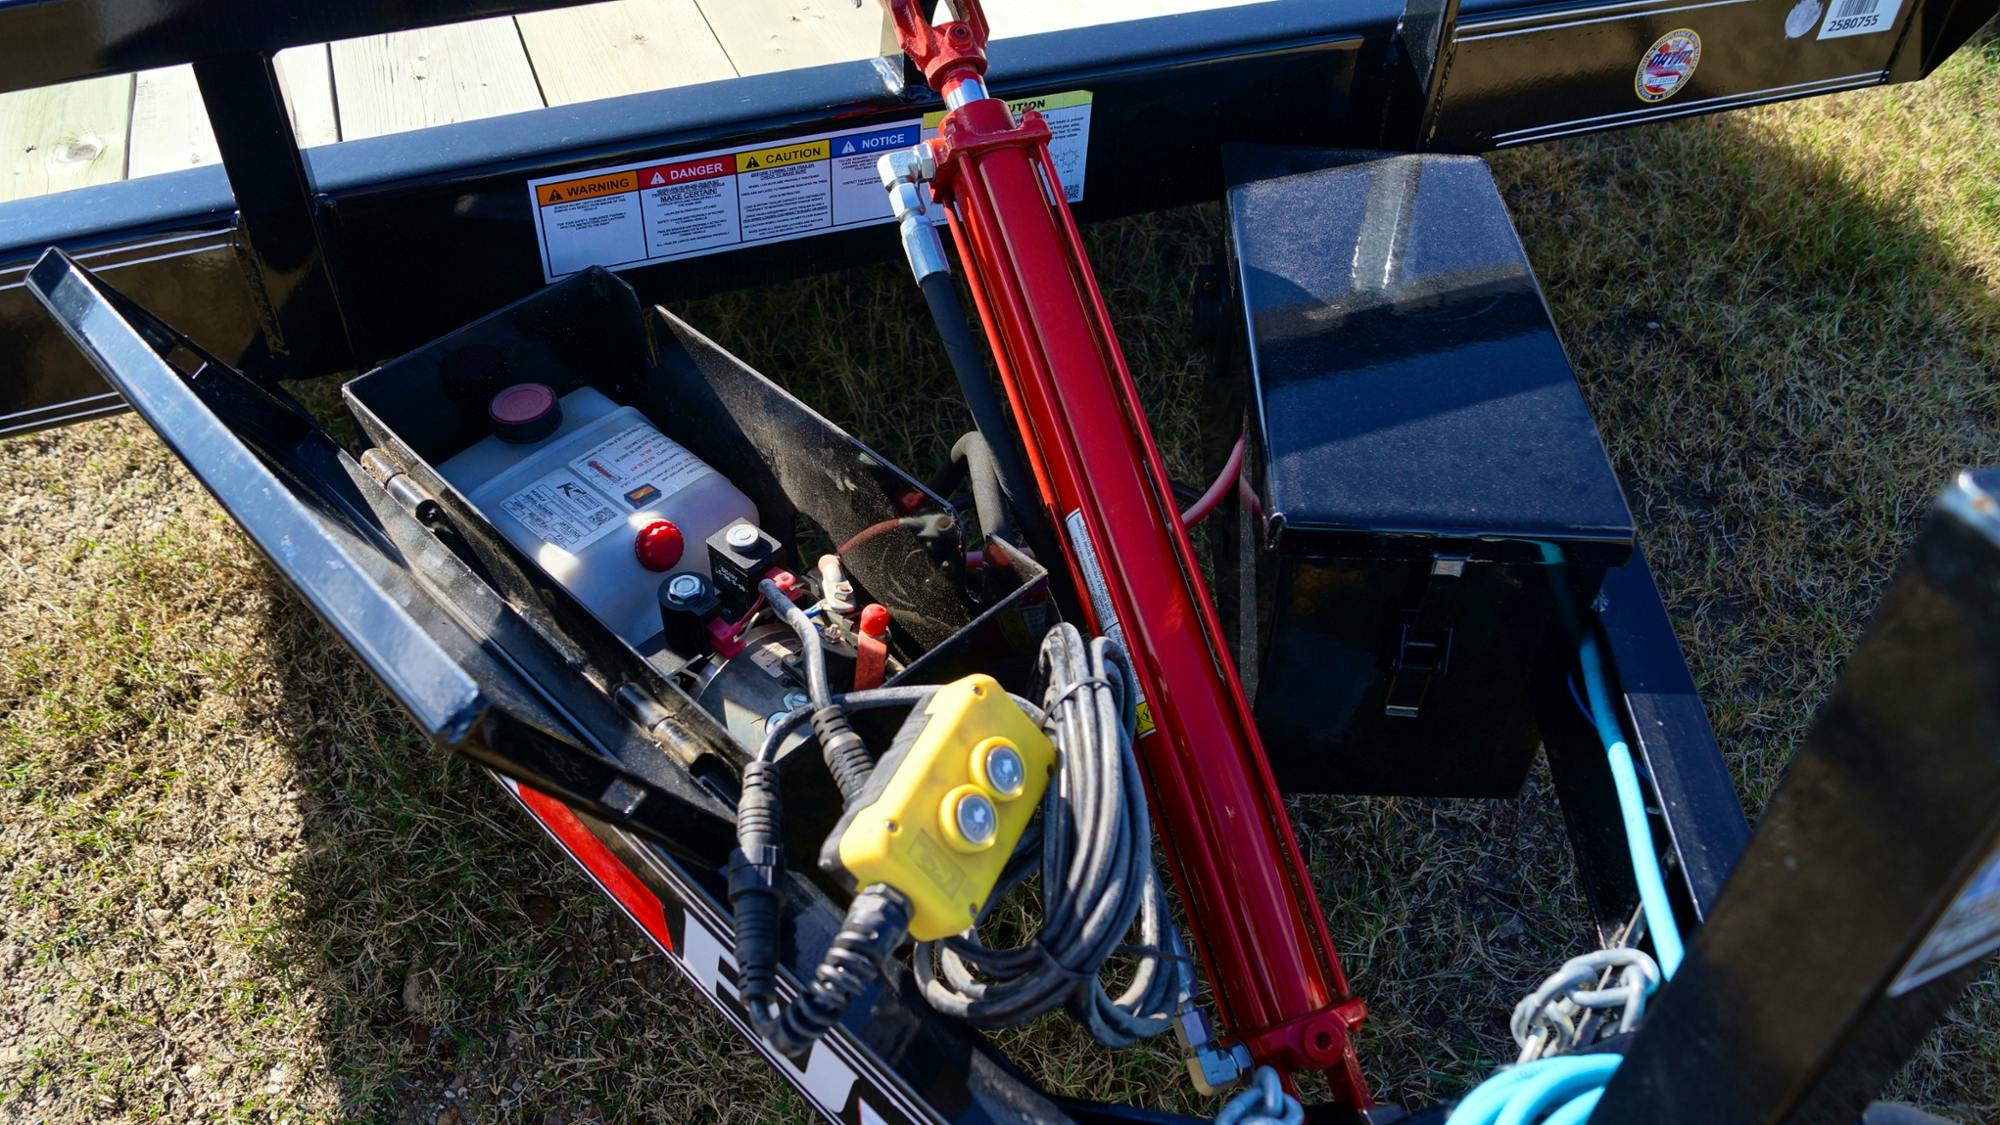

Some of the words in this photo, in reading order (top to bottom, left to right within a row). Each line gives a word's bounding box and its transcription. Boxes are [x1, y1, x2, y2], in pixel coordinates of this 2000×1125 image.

[1828, 14, 1880, 32] 2580755
[1008, 99, 1046, 113] UTION
[862, 133, 905, 149] NOTICE
[765, 147, 821, 164] CAUTION
[670, 163, 724, 180] DANGER
[566, 178, 630, 197] WARNING
[661, 193, 684, 203] MAKE
